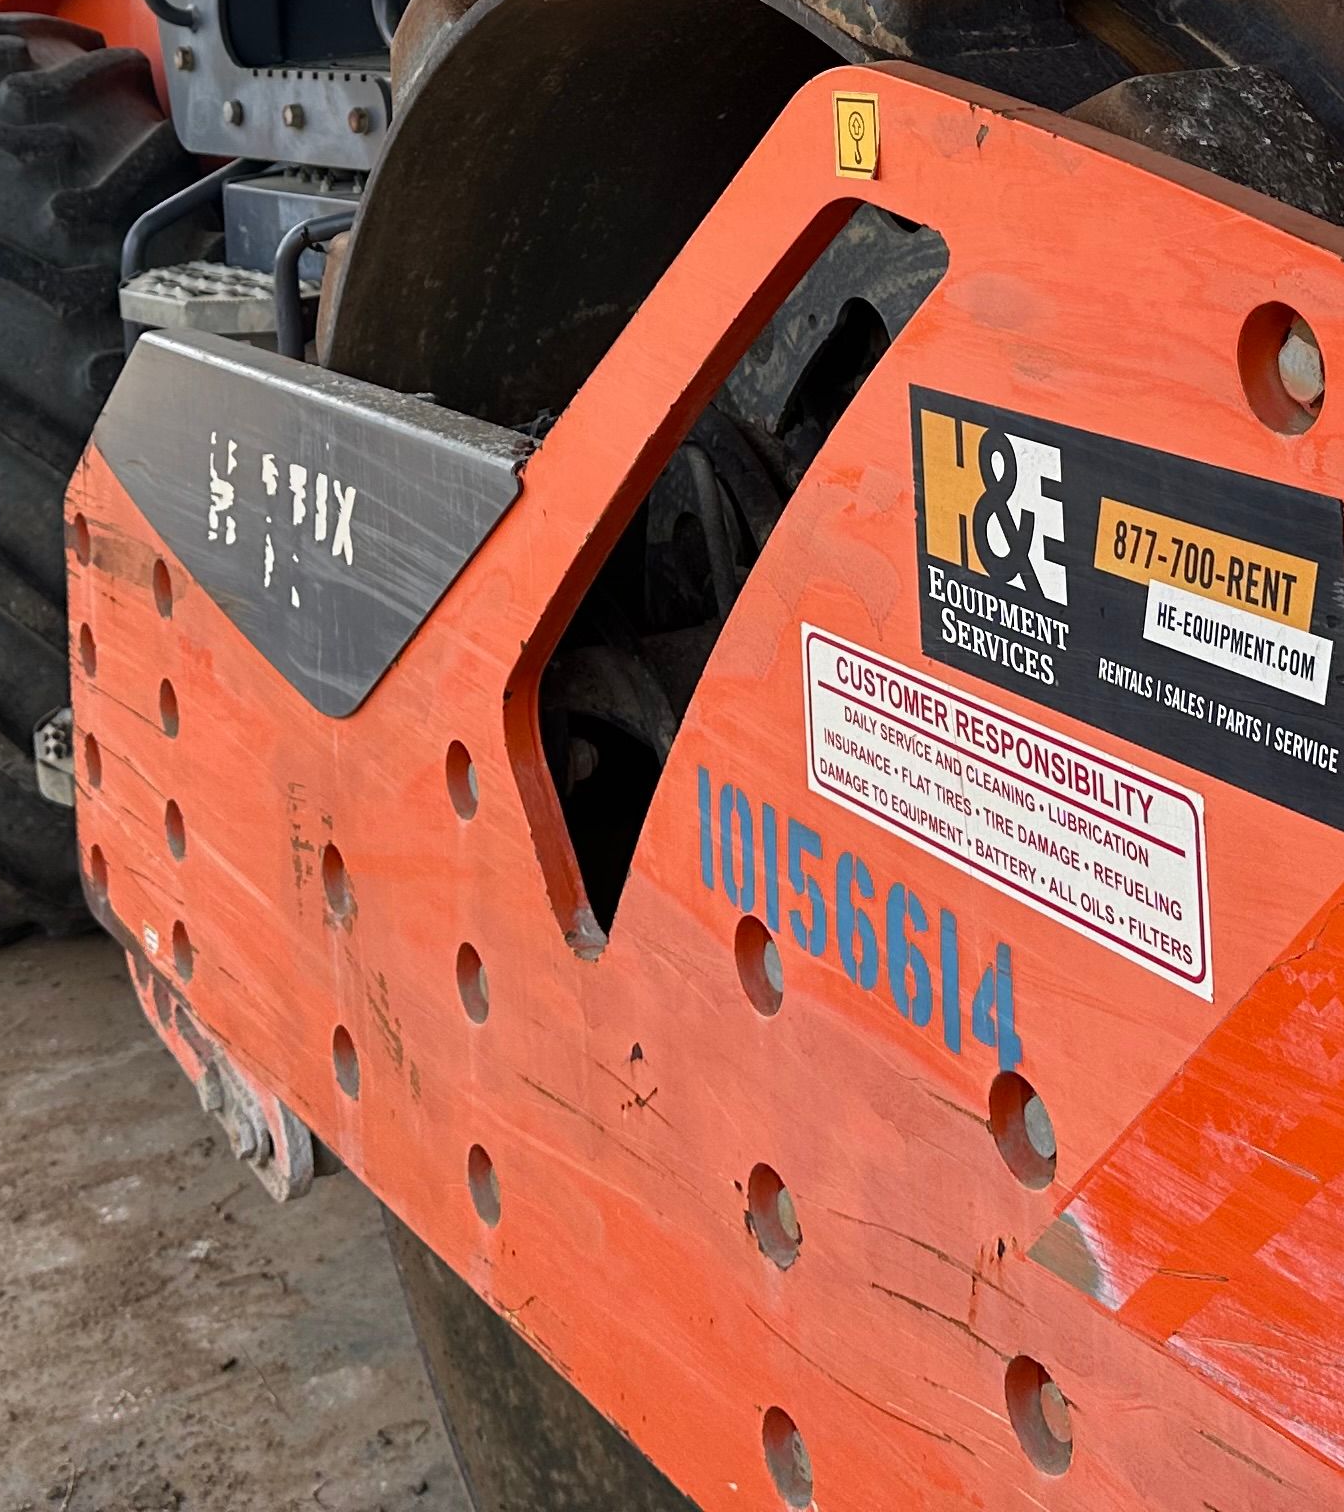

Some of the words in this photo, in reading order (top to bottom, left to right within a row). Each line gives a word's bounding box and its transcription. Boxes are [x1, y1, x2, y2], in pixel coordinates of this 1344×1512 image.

[920, 408, 1068, 606] H&E
[1113, 520, 1298, 616] 877-700-RENT
[927, 564, 1069, 651] EQUIPMENT
[941, 607, 1056, 686] SERVICES
[1156, 601, 1316, 682] HE-EQUIPMENT.COM
[836, 656, 949, 733] CUSTOMER
[955, 708, 1154, 824] RESPONSIBILITY
[844, 705, 877, 735] DAILY
[880, 723, 932, 763] SERVICE
[935, 750, 962, 777] AND
[966, 764, 1035, 812] CLEANING
[1047, 803, 1149, 868] LUBRICATION
[1098, 657, 1153, 699] RENTALS
[1164, 683, 1205, 720] SALES
[1216, 703, 1262, 743] PARTS
[1274, 726, 1339, 774] SERVICE
[820, 757, 869, 797] DAMAGE
[872, 784, 888, 806] TO
[891, 795, 963, 846] EQUIPMENT
[975, 838, 1037, 885] BATTERY
[1049, 877, 1078, 906] ALL
[1080, 892, 1115, 925] OILS
[1128, 916, 1193, 965] FILTERS
[823, 728, 891, 776] INSURANCE
[901, 766, 931, 796] FLAT
[934, 782, 972, 816] TIRES
[983, 807, 1014, 838] TIRE
[1017, 824, 1081, 871] DAMAGE
[1093, 861, 1183, 921] REFUELING
[698, 764, 1023, 1071] 10156614
